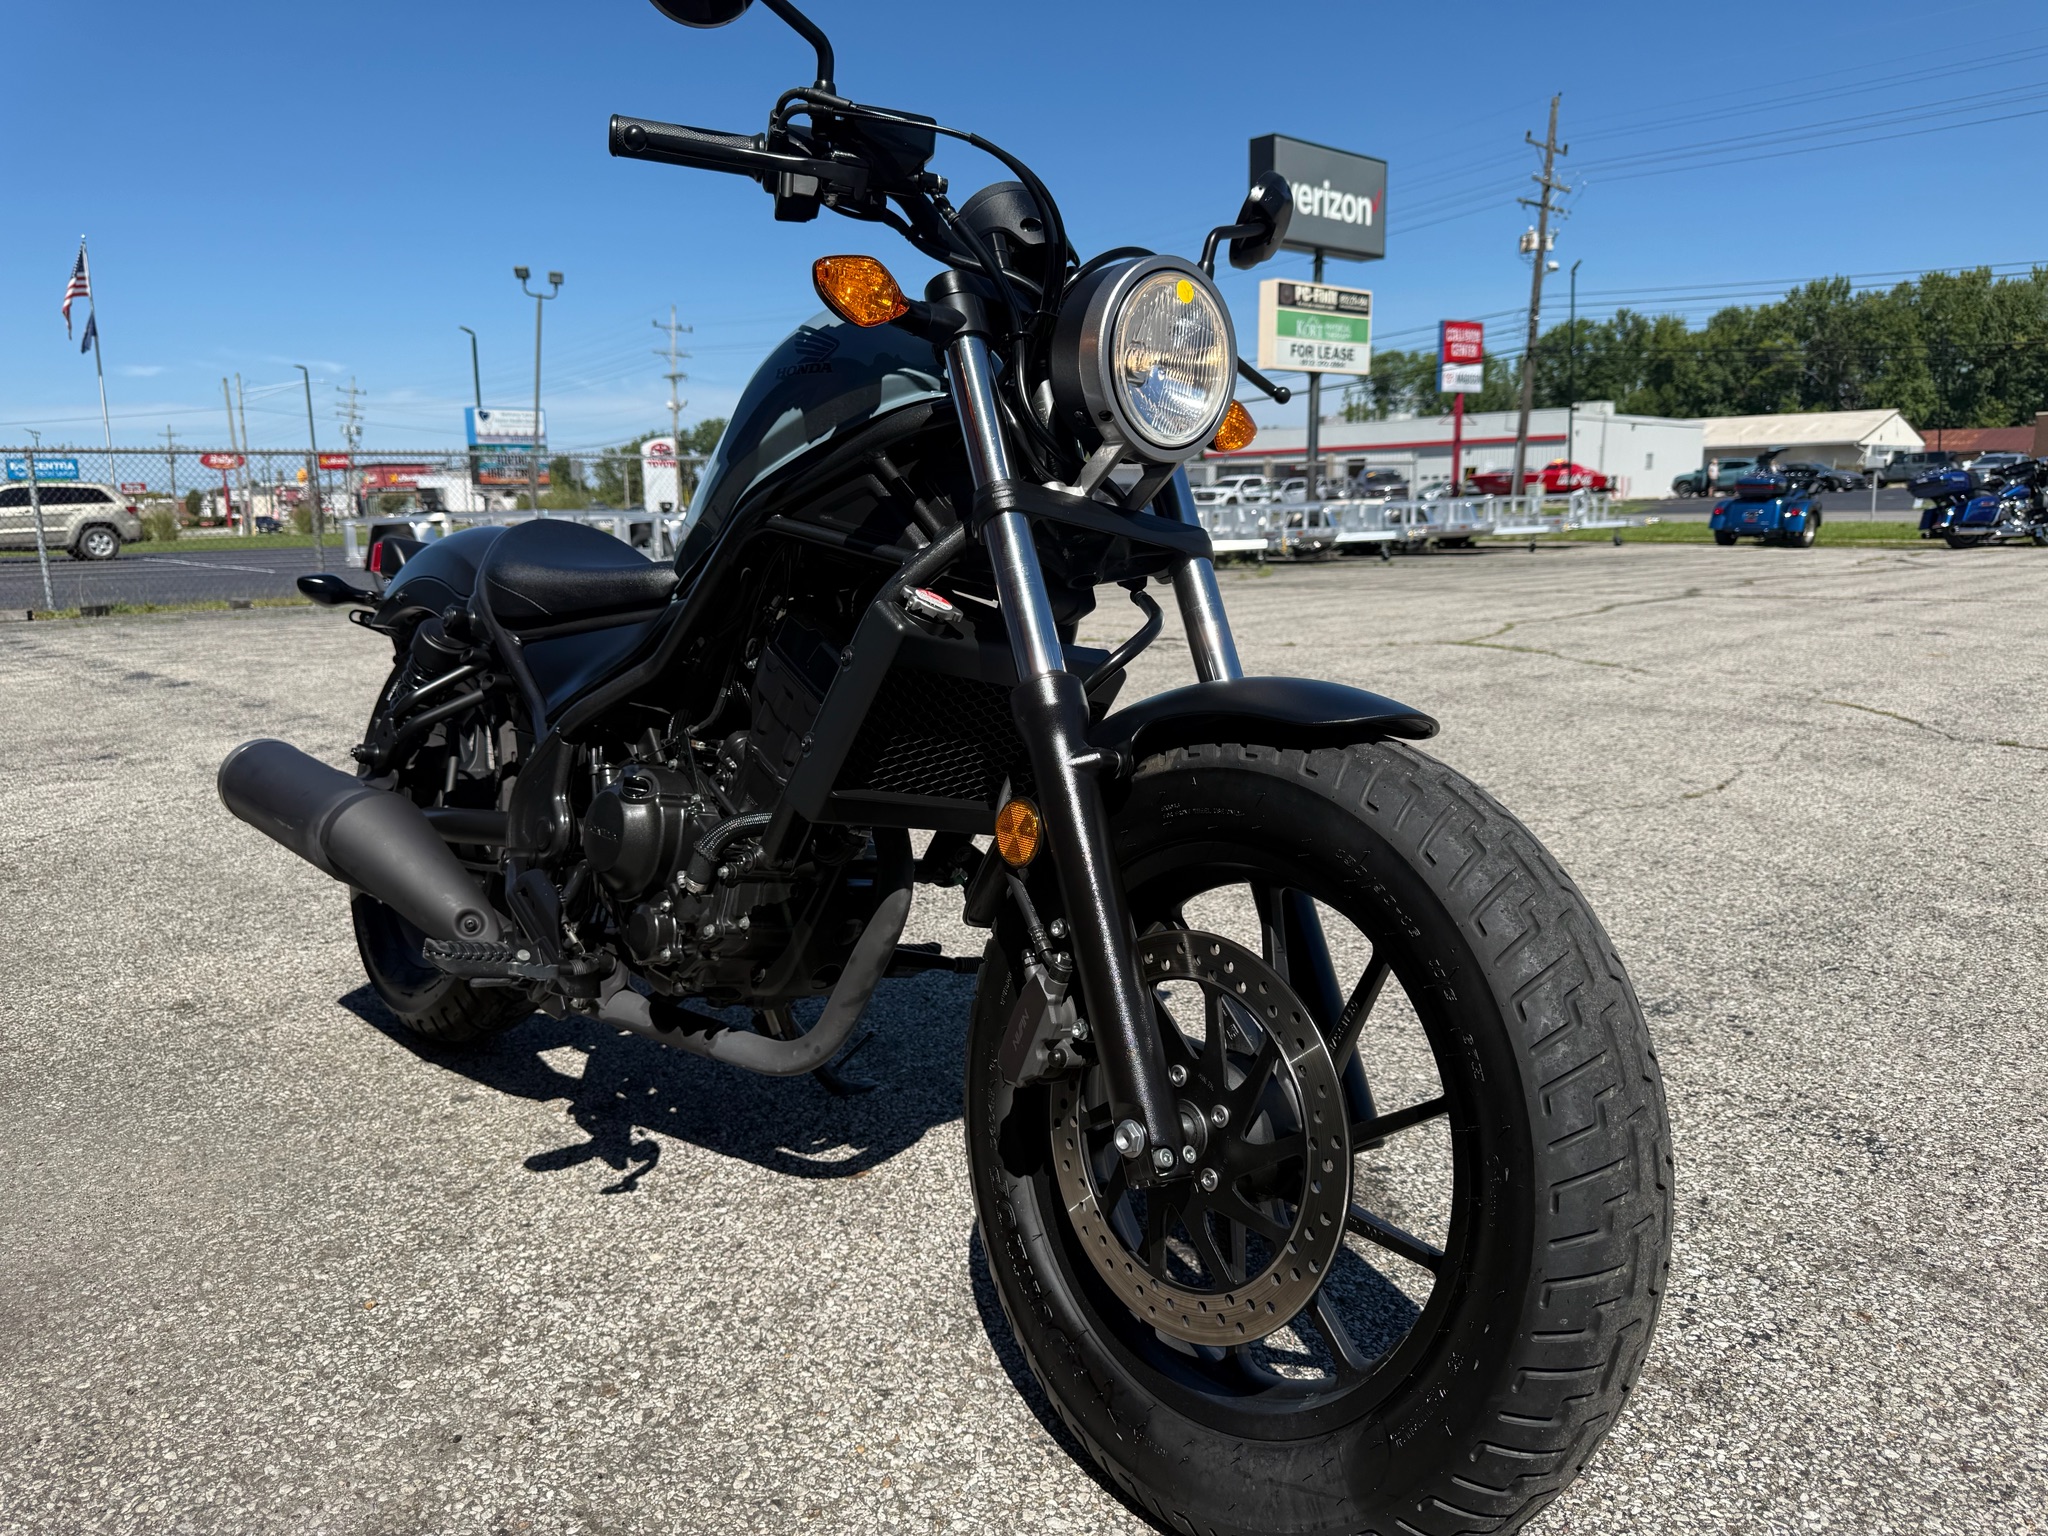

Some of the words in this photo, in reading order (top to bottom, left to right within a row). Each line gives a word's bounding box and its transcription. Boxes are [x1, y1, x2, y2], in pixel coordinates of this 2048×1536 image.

[1287, 180, 1372, 226] verizon
[1290, 344, 1314, 358] FOR
[1317, 345, 1355, 361] LEASE
[775, 362, 833, 379] HONDA
